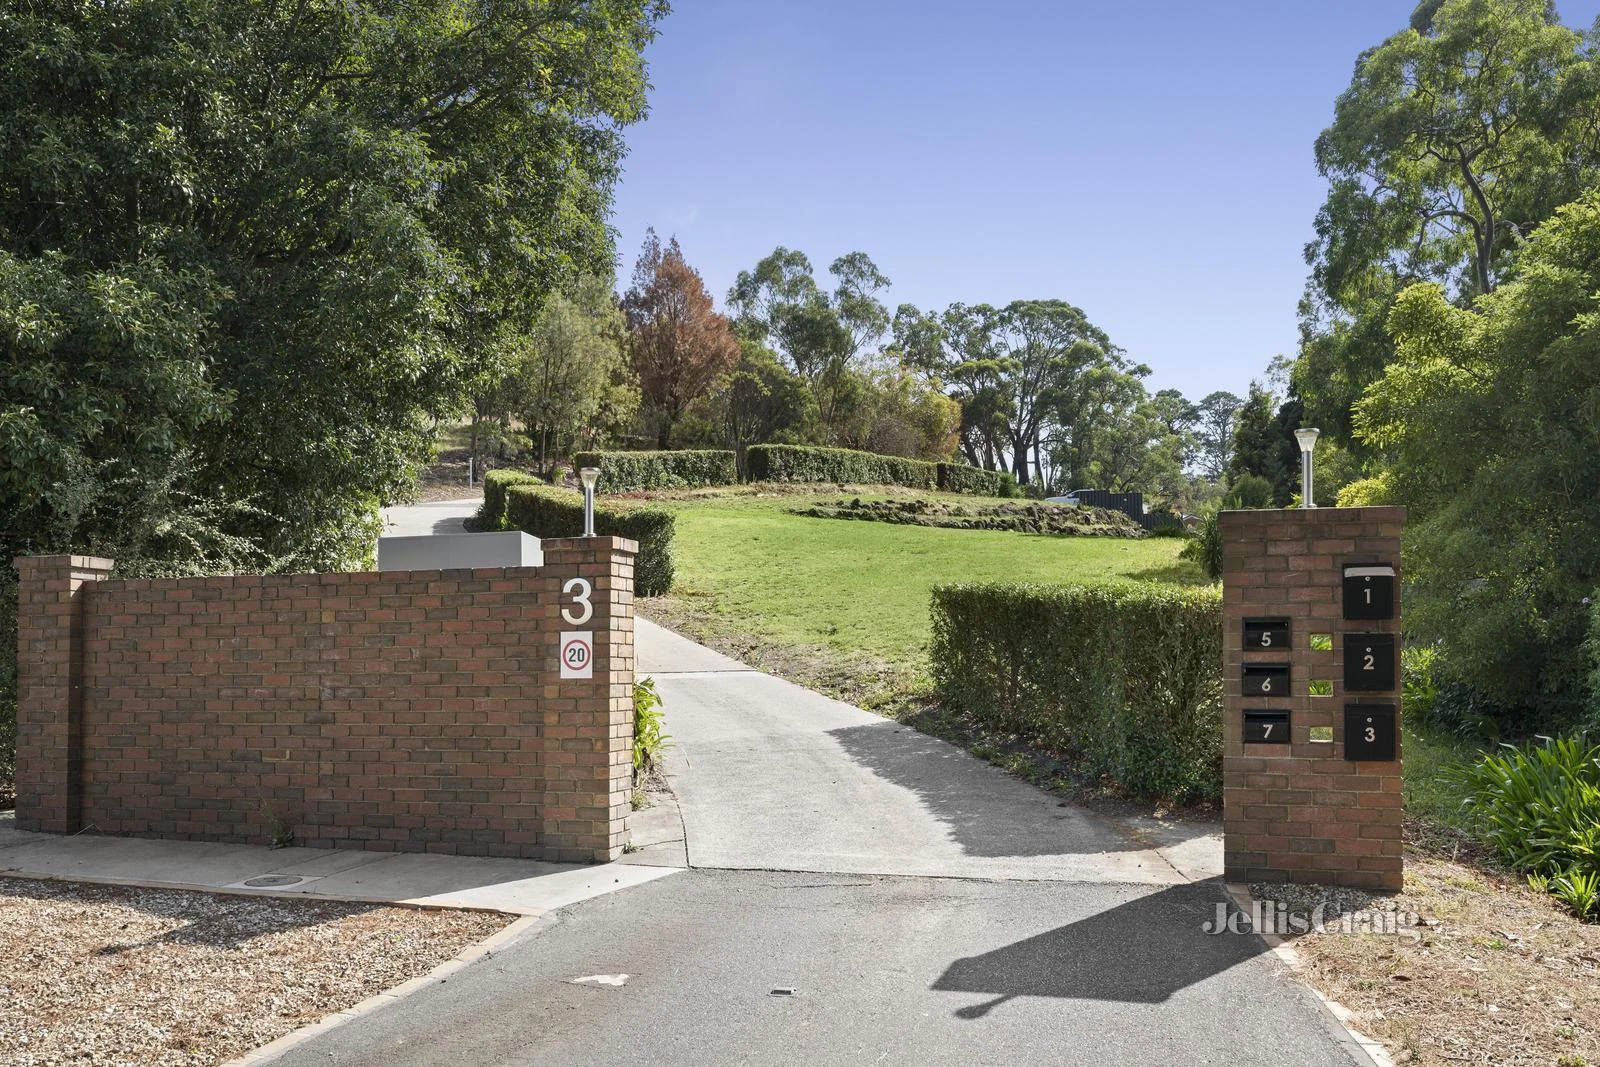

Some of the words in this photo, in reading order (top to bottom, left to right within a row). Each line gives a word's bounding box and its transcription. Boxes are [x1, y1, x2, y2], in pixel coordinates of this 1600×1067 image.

[561, 577, 593, 625] 3
[1364, 588, 1371, 604] 1
[1261, 631, 1272, 647] 5
[568, 647, 585, 662] 20
[1363, 654, 1375, 670] 2
[1261, 677, 1271, 692] 6
[1263, 724, 1273, 739] 7
[1364, 727, 1375, 742] 3
